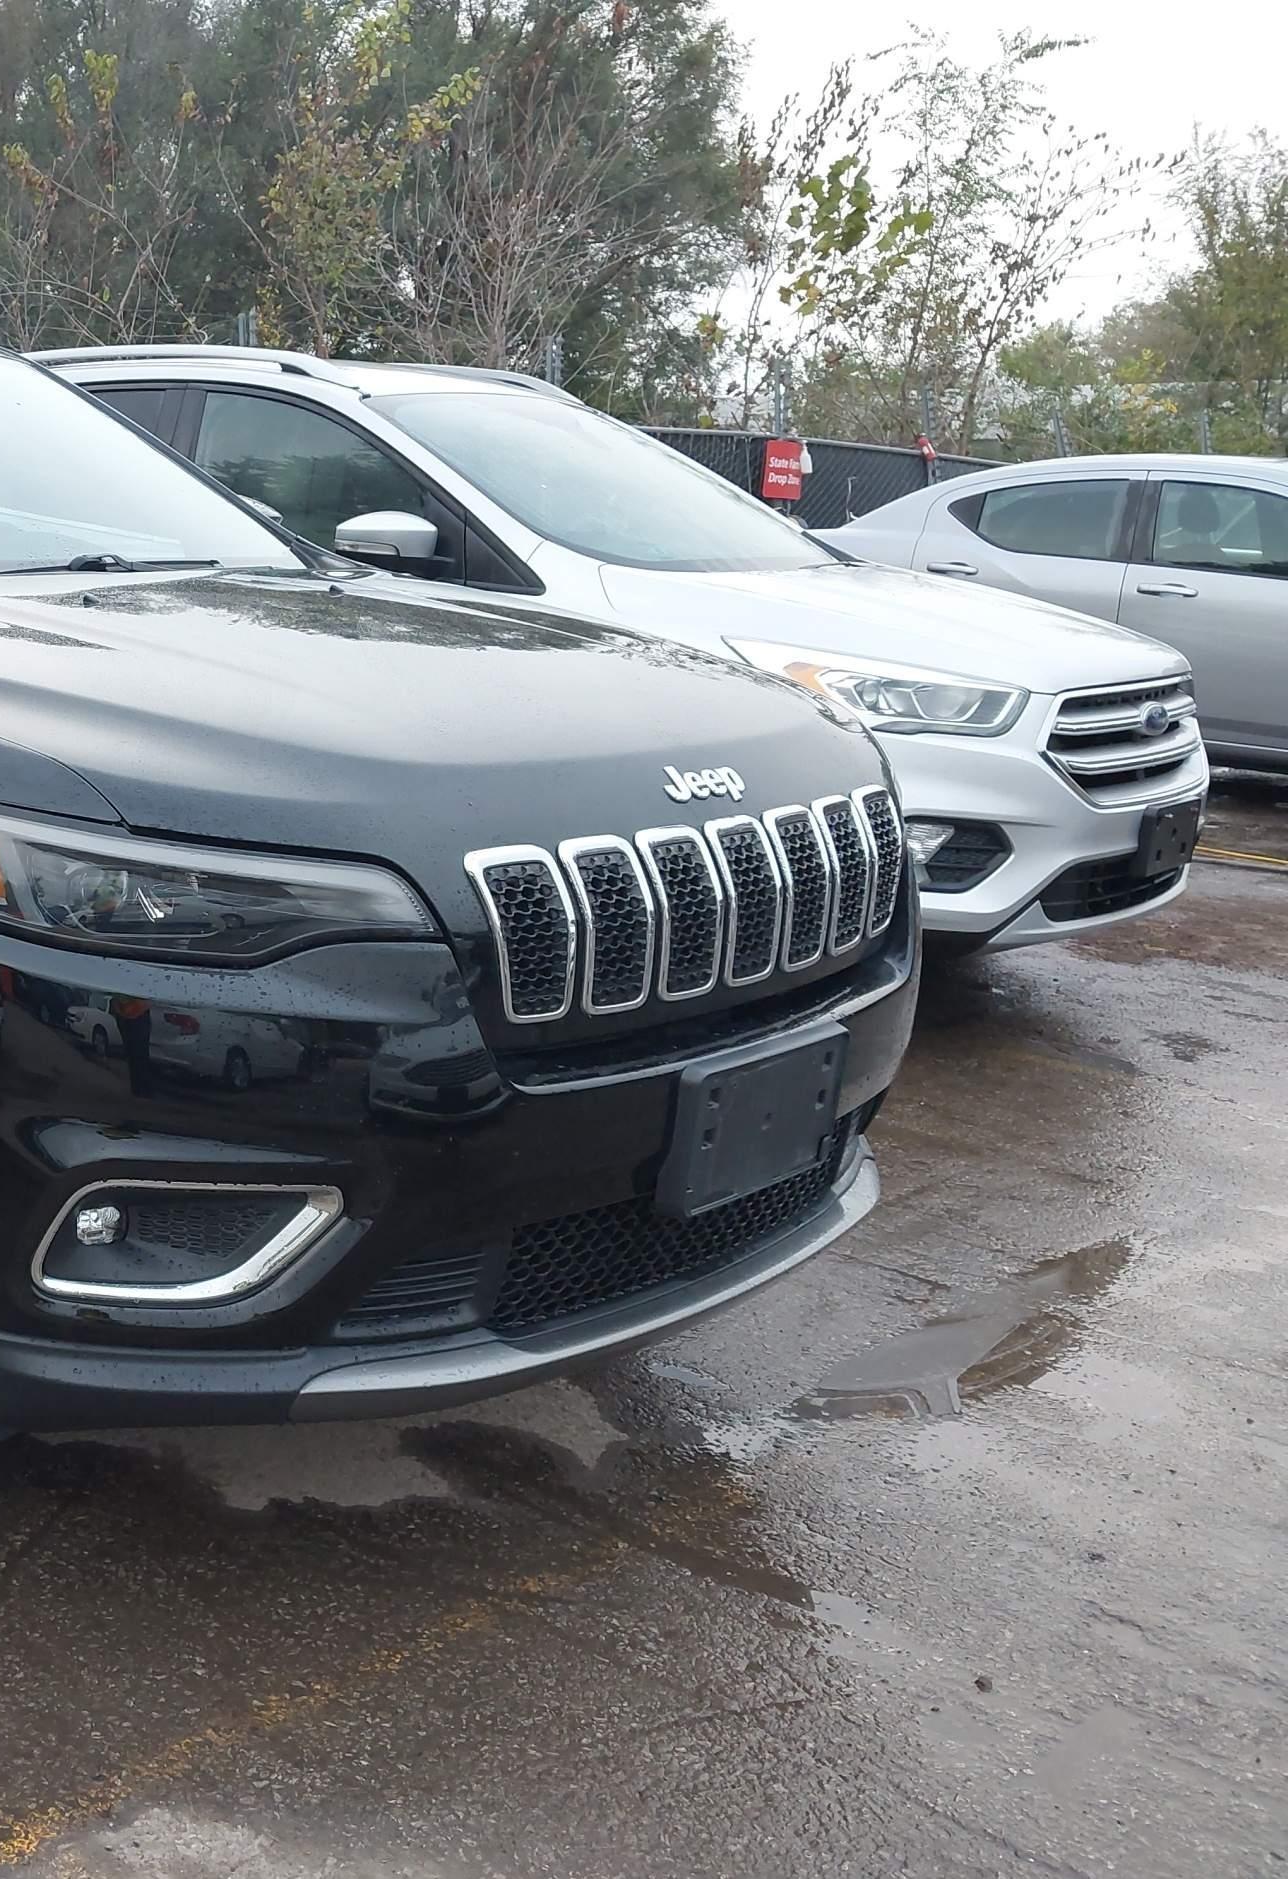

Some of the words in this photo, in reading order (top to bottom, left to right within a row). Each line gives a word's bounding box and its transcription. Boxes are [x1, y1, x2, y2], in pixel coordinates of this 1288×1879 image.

[769, 456, 789, 469] State
[768, 472, 787, 487] Drop
[663, 765, 746, 803] Jeep
